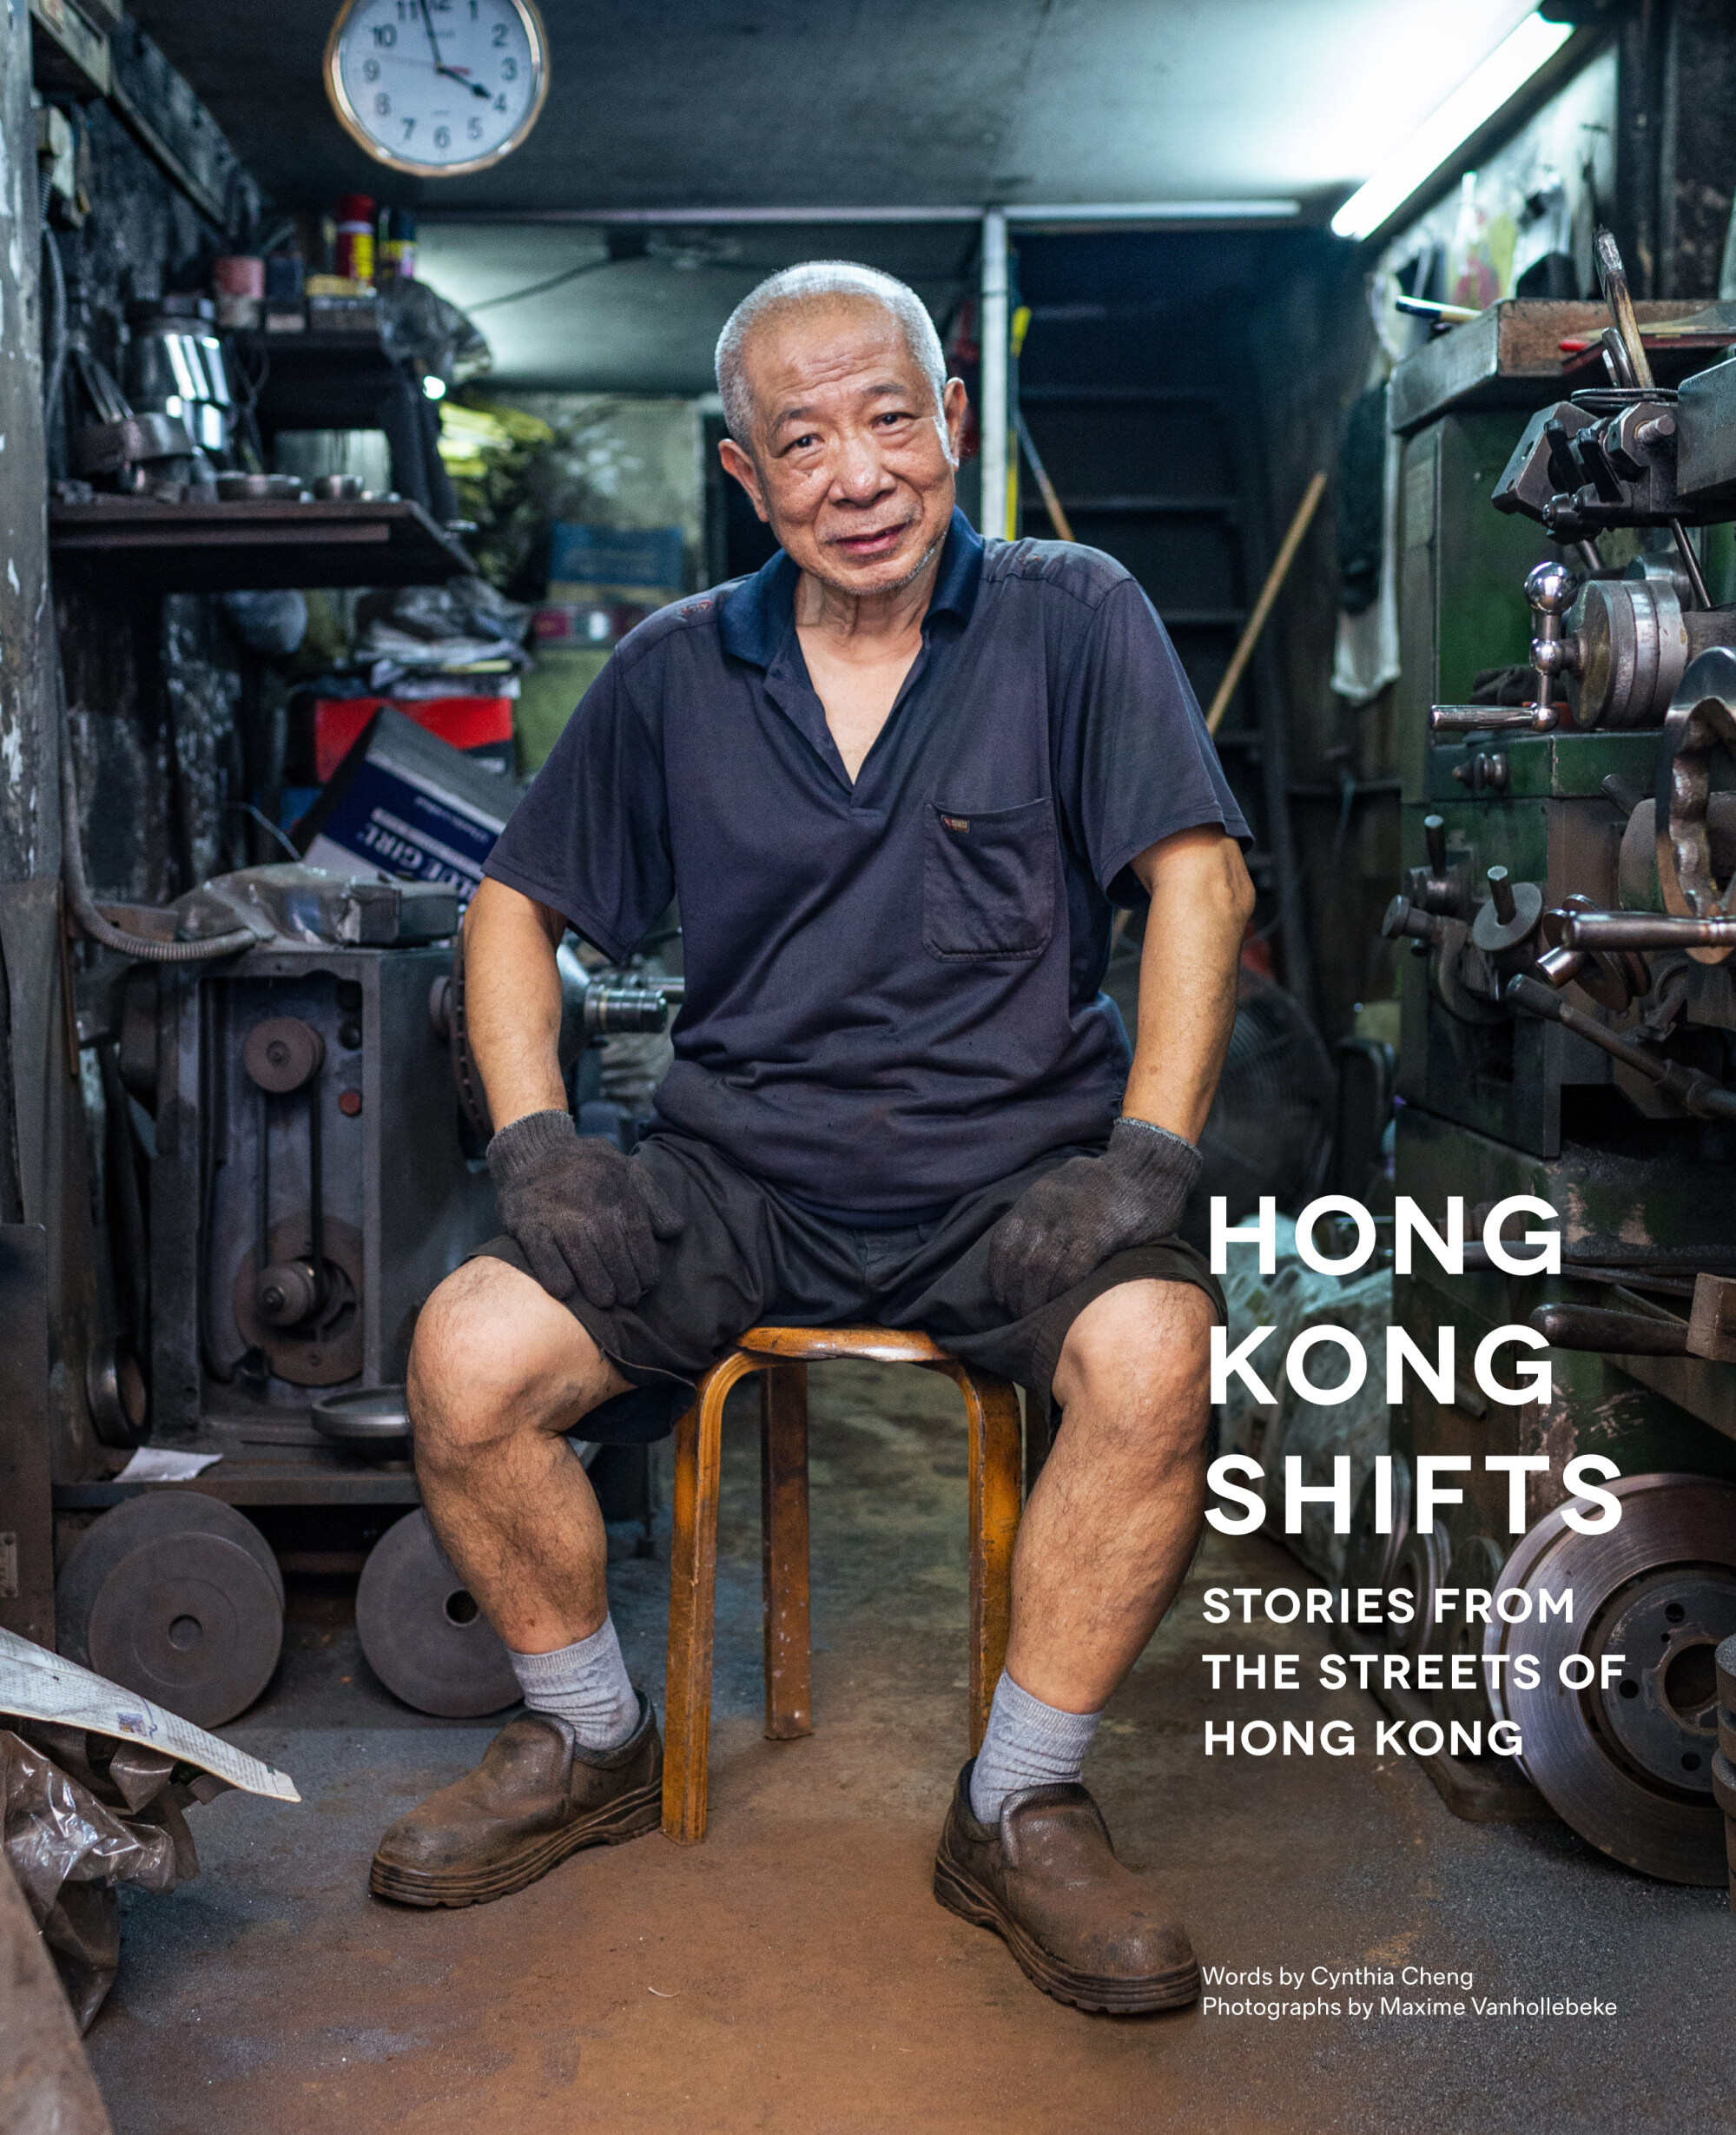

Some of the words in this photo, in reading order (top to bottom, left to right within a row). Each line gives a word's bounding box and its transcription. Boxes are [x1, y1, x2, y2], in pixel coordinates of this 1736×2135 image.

[372, 23, 398, 49] 10
[491, 22, 508, 48] 2
[362, 57, 380, 83] 9
[500, 56, 518, 82] 3
[374, 92, 391, 118] 8
[492, 92, 507, 112] 4
[400, 117, 416, 141] 7
[434, 125, 451, 150] 6
[467, 116, 483, 141] 5
[365, 823, 424, 870] GIRL
